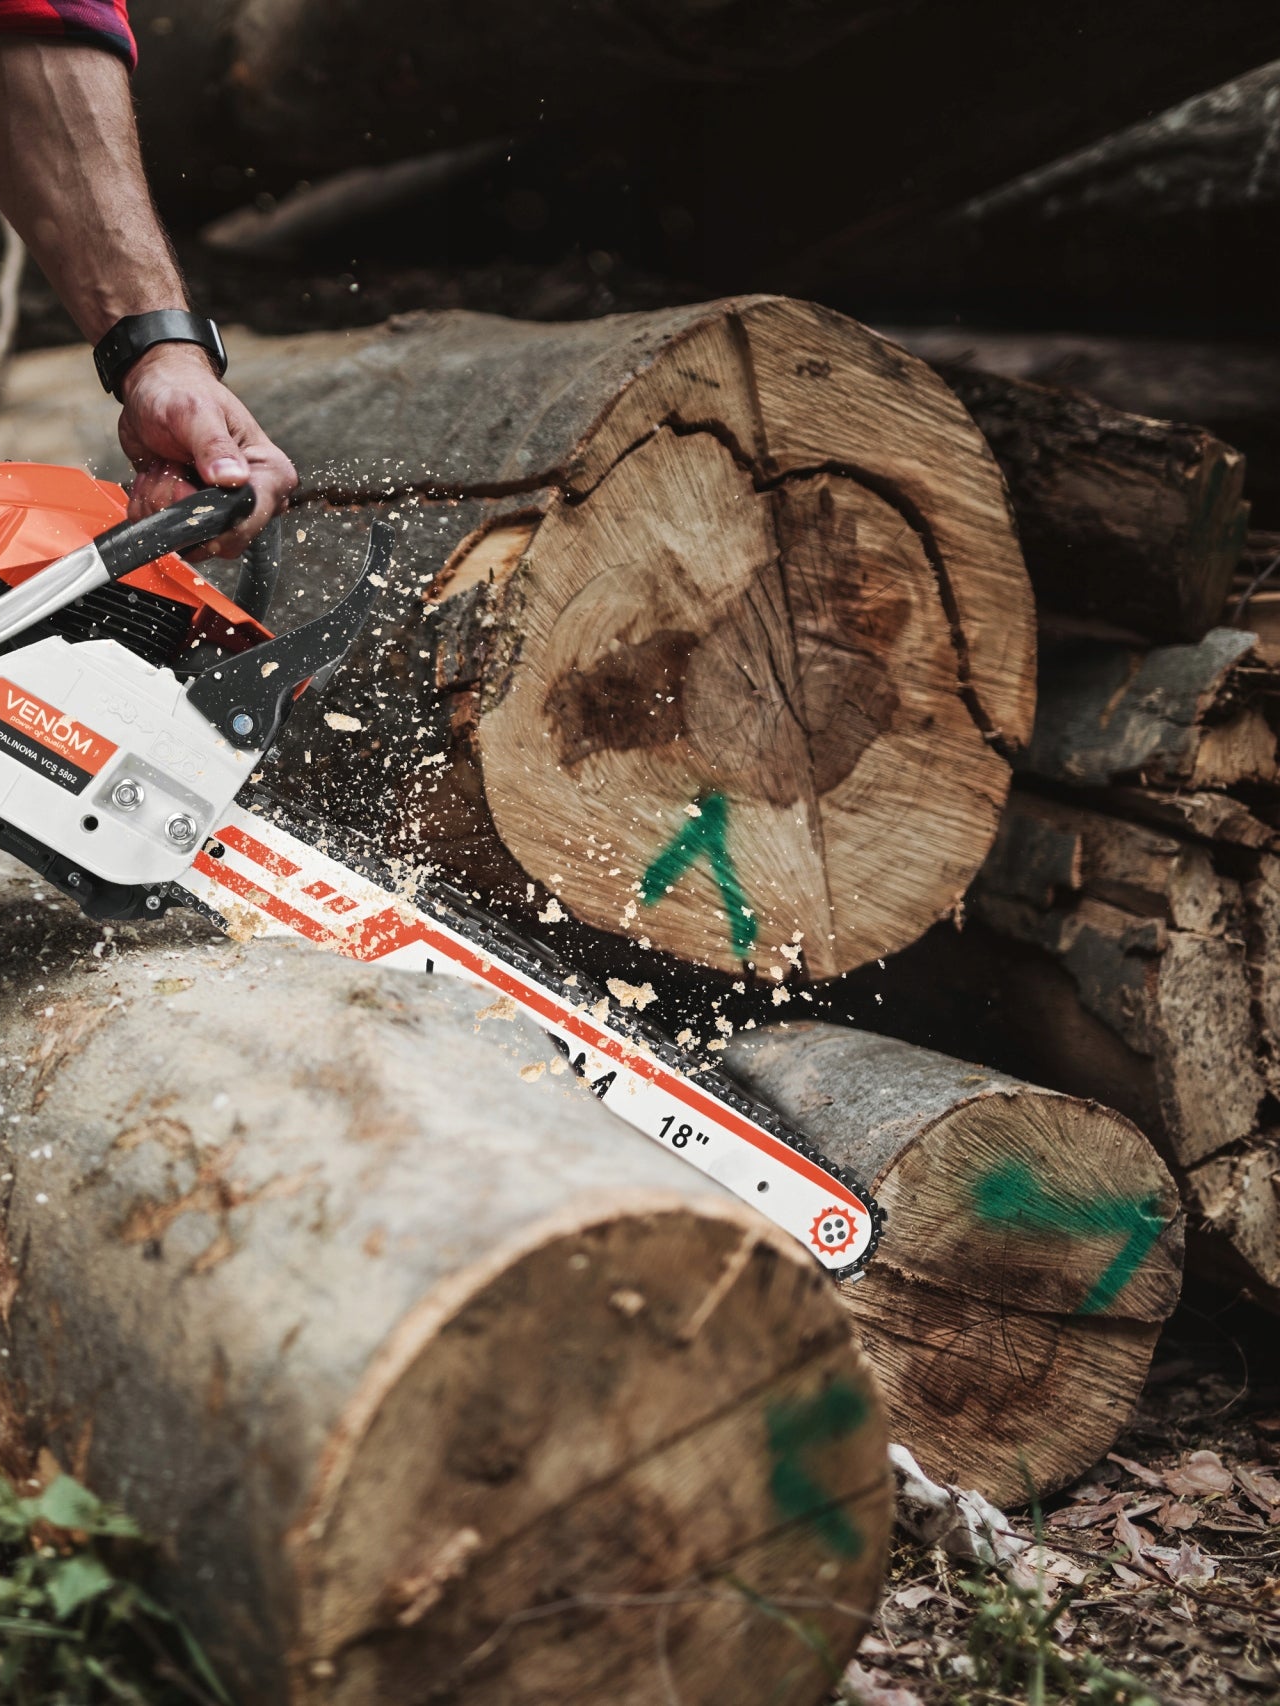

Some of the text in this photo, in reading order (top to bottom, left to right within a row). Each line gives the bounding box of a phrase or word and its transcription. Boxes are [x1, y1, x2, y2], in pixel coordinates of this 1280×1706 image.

[7, 689, 93, 755] VENOM
[10, 715, 34, 730] power
[34, 729, 44, 738] of
[41, 757, 58, 772] VCS
[58, 768, 78, 784] 5802
[659, 1115, 710, 1148] 18"
